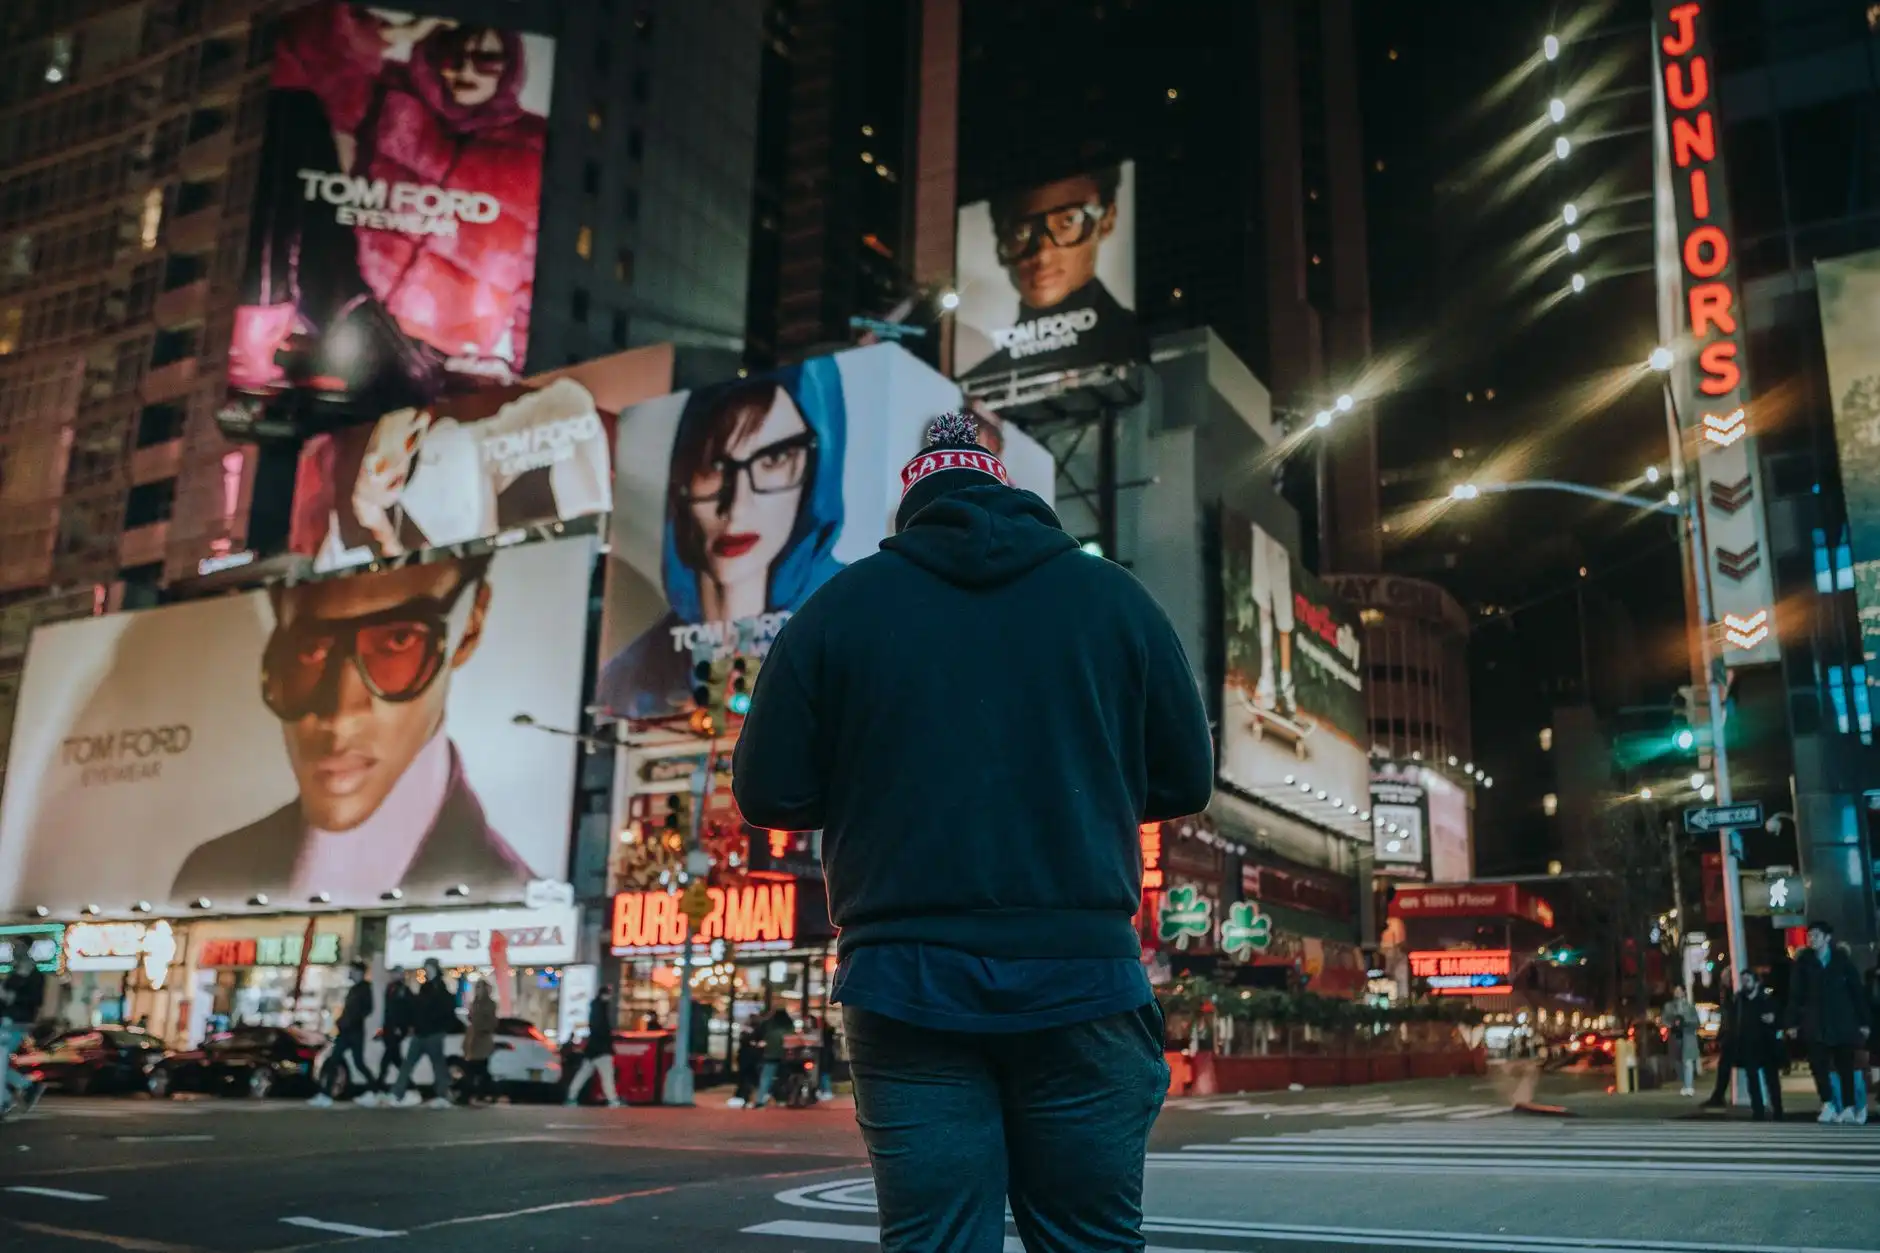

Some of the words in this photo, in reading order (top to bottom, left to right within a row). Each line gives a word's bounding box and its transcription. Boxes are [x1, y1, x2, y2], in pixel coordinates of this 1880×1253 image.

[297, 168, 387, 209] TOM
[391, 183, 500, 224] FORD
[1662, 2, 1741, 396] JUNIORS
[1037, 307, 1098, 341] FORD
[62, 732, 115, 766] TOM
[120, 724, 192, 759] FORD
